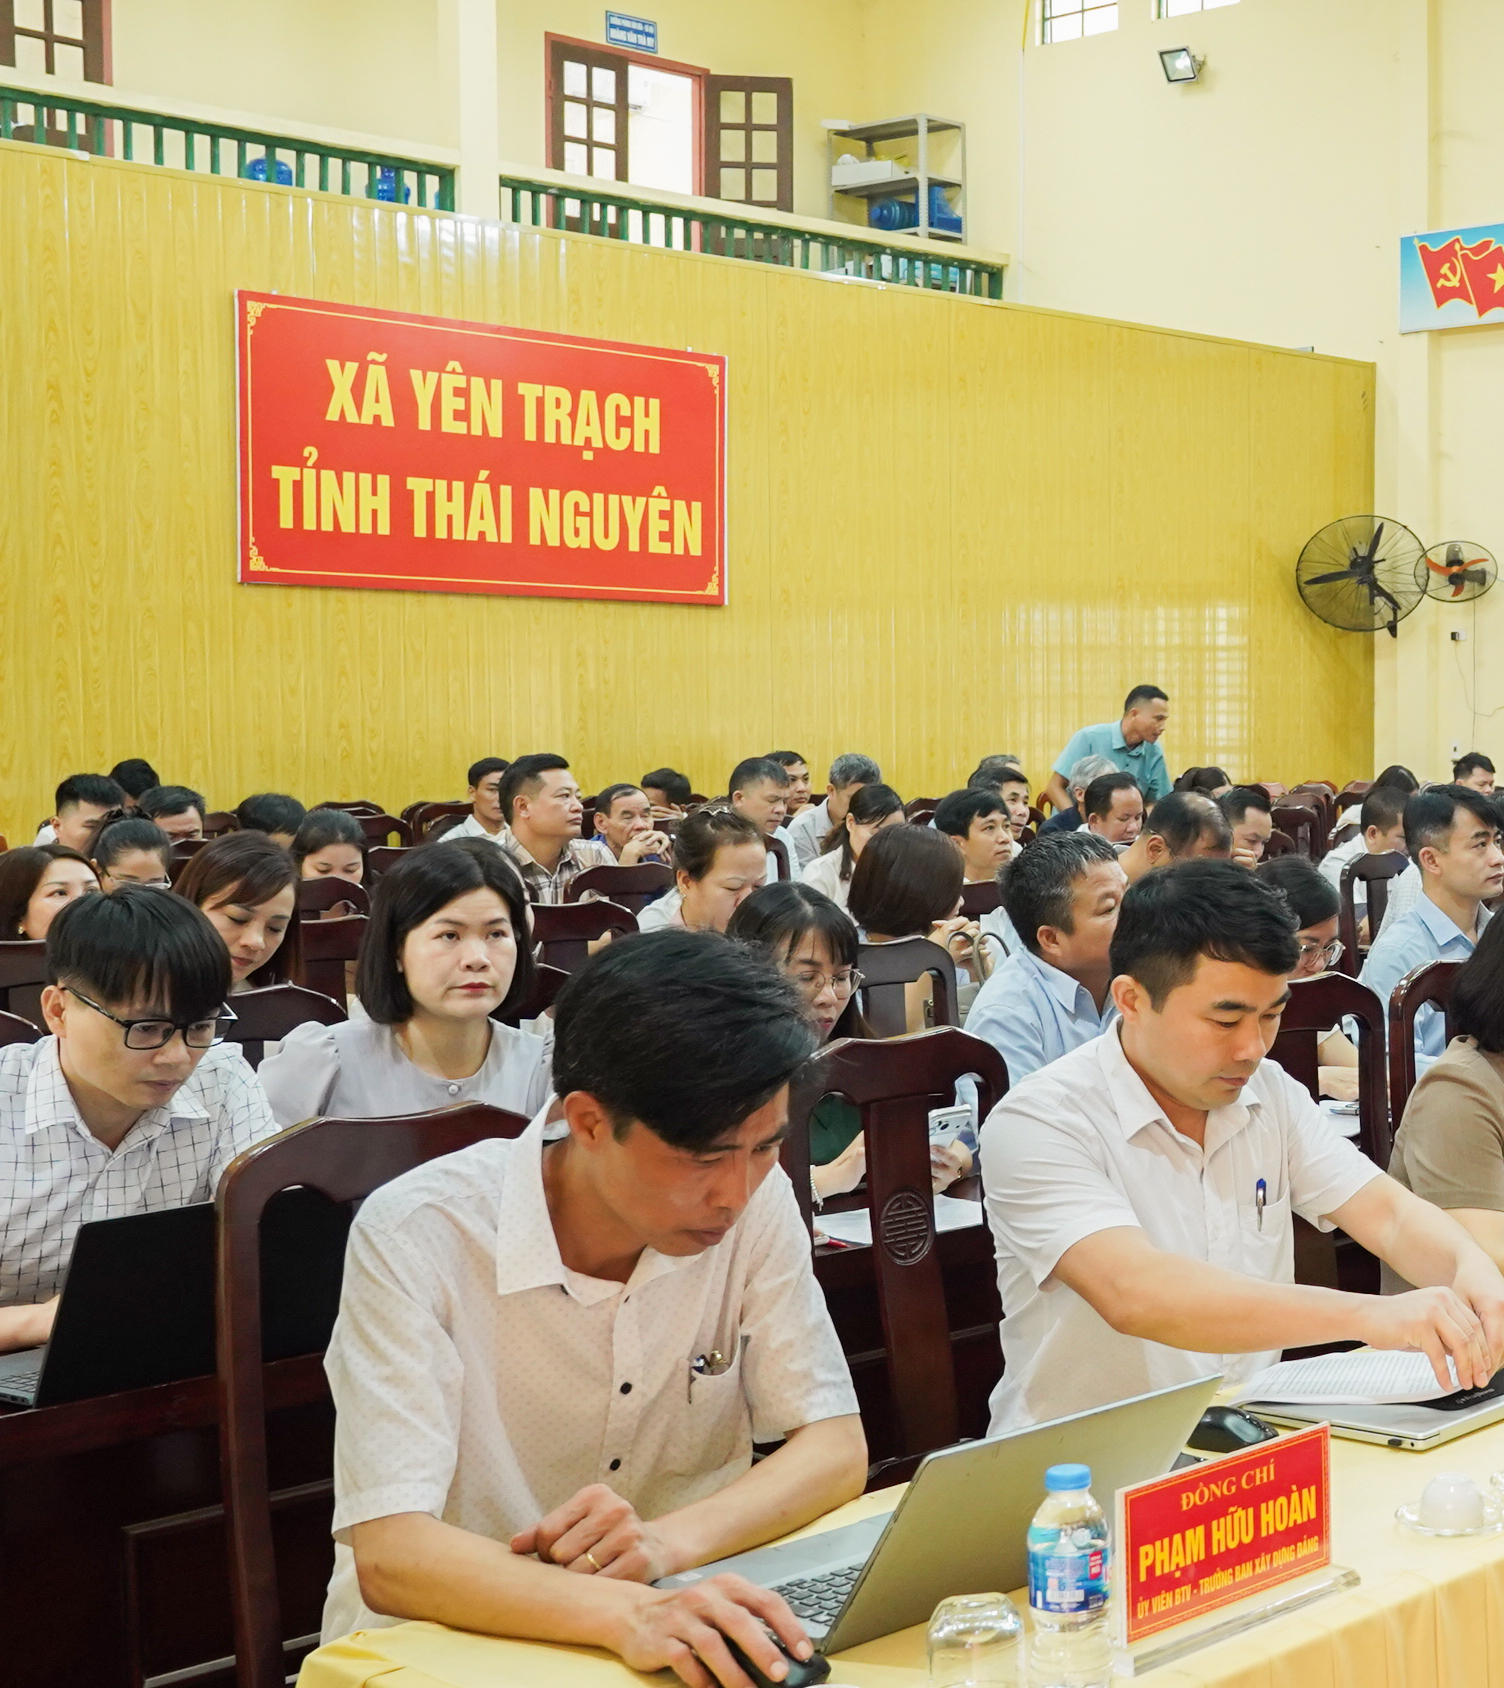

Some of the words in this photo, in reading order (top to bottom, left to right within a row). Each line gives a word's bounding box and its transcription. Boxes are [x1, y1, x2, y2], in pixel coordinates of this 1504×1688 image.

[325, 351, 395, 427] XÃ
[409, 361, 503, 438] YÊN
[517, 382, 661, 461] TRẠCH
[271, 446, 391, 536] TỈNH
[406, 470, 512, 544] THÁI
[529, 486, 702, 556] NGUYÊN
[1241, 1458, 1274, 1490] CHÍ
[1137, 1596, 1149, 1620] ỦY
[1151, 1589, 1173, 1615] VIÊN
[1174, 1583, 1191, 1606] BTV
[1199, 1567, 1232, 1596] TRƯỞNG
[1234, 1560, 1252, 1583] BAN
[1254, 1552, 1271, 1575] XÂY
[1272, 1543, 1295, 1568] DỰNG
[1297, 1534, 1318, 1558] ĐẢNG
[1139, 1524, 1205, 1583] PHẠM
[1212, 1506, 1253, 1556] HỮU
[1260, 1484, 1316, 1538] HOÀN
